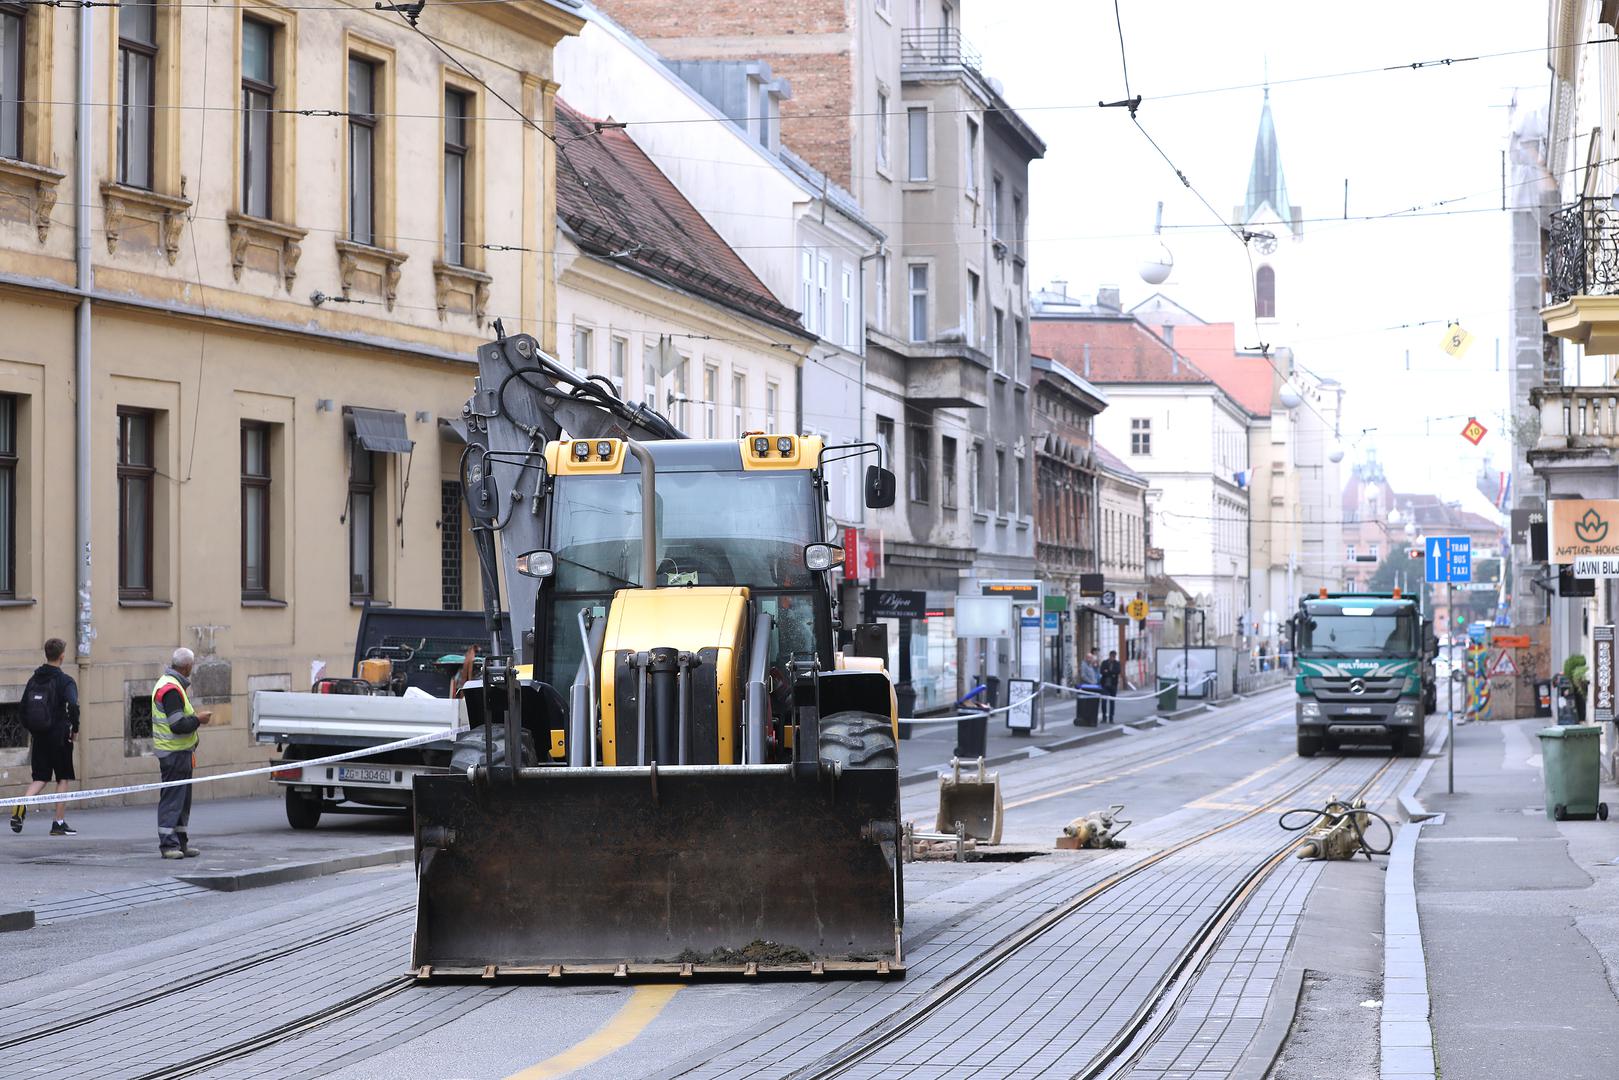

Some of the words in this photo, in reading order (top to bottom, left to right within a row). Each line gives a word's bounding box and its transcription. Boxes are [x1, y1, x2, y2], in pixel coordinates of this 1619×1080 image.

[1452, 335, 1461, 347] 5
[1469, 427, 1480, 437] 10
[1451, 543, 1469, 552] TRAM
[1453, 555, 1467, 564] BUS
[1452, 566, 1468, 575] TAXI
[1576, 561, 1600, 575] JAVNI
